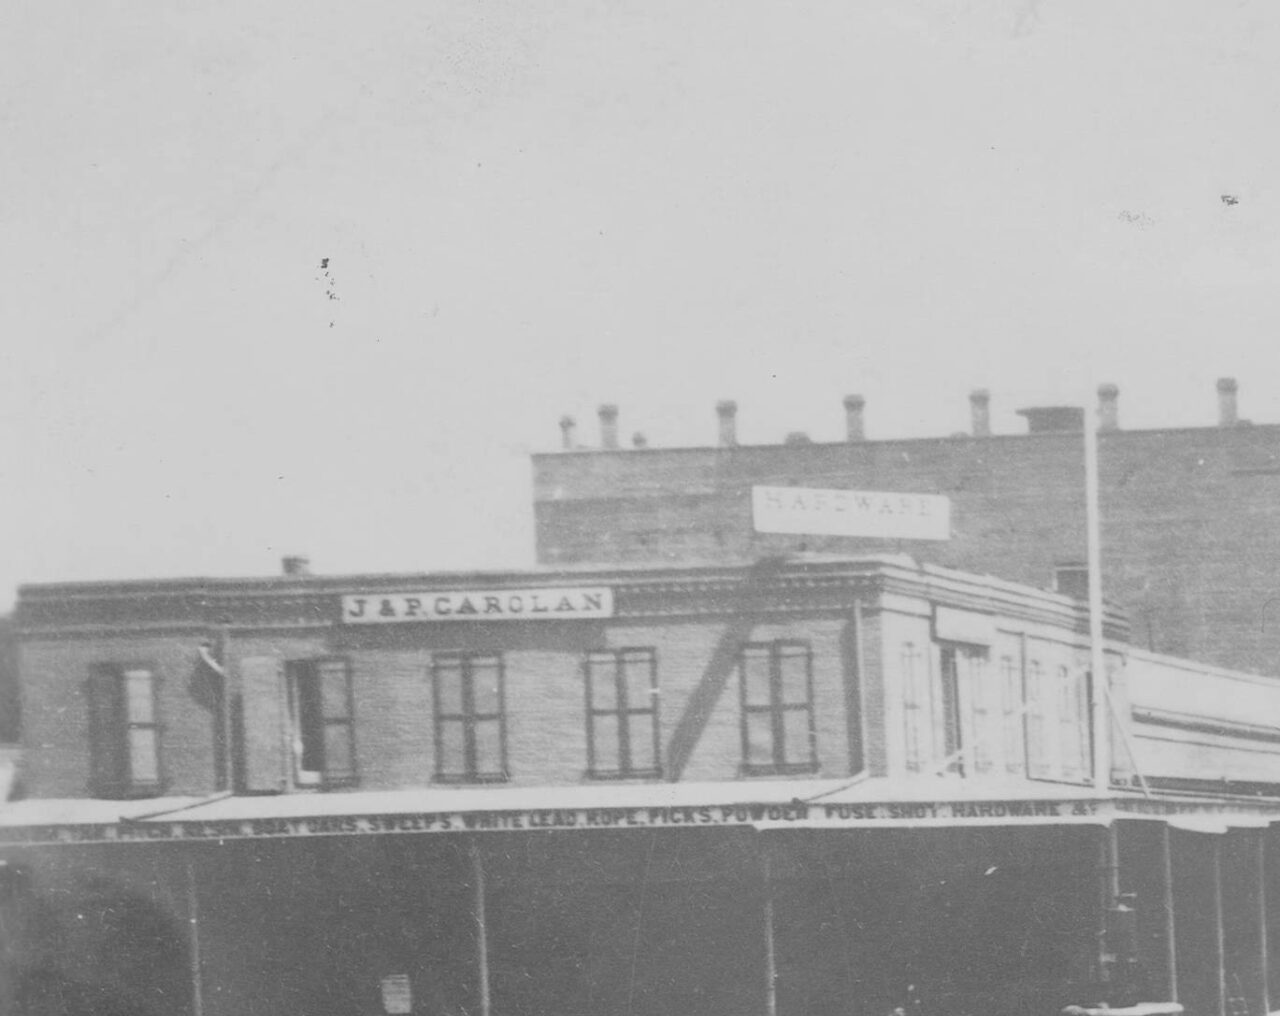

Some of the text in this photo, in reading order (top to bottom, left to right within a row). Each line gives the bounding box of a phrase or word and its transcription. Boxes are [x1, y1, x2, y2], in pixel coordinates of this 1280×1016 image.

[348, 598, 368, 618] J
[378, 598, 397, 617] &
[433, 592, 604, 616] CAROLAN
[951, 800, 1061, 818] HARDWARE
